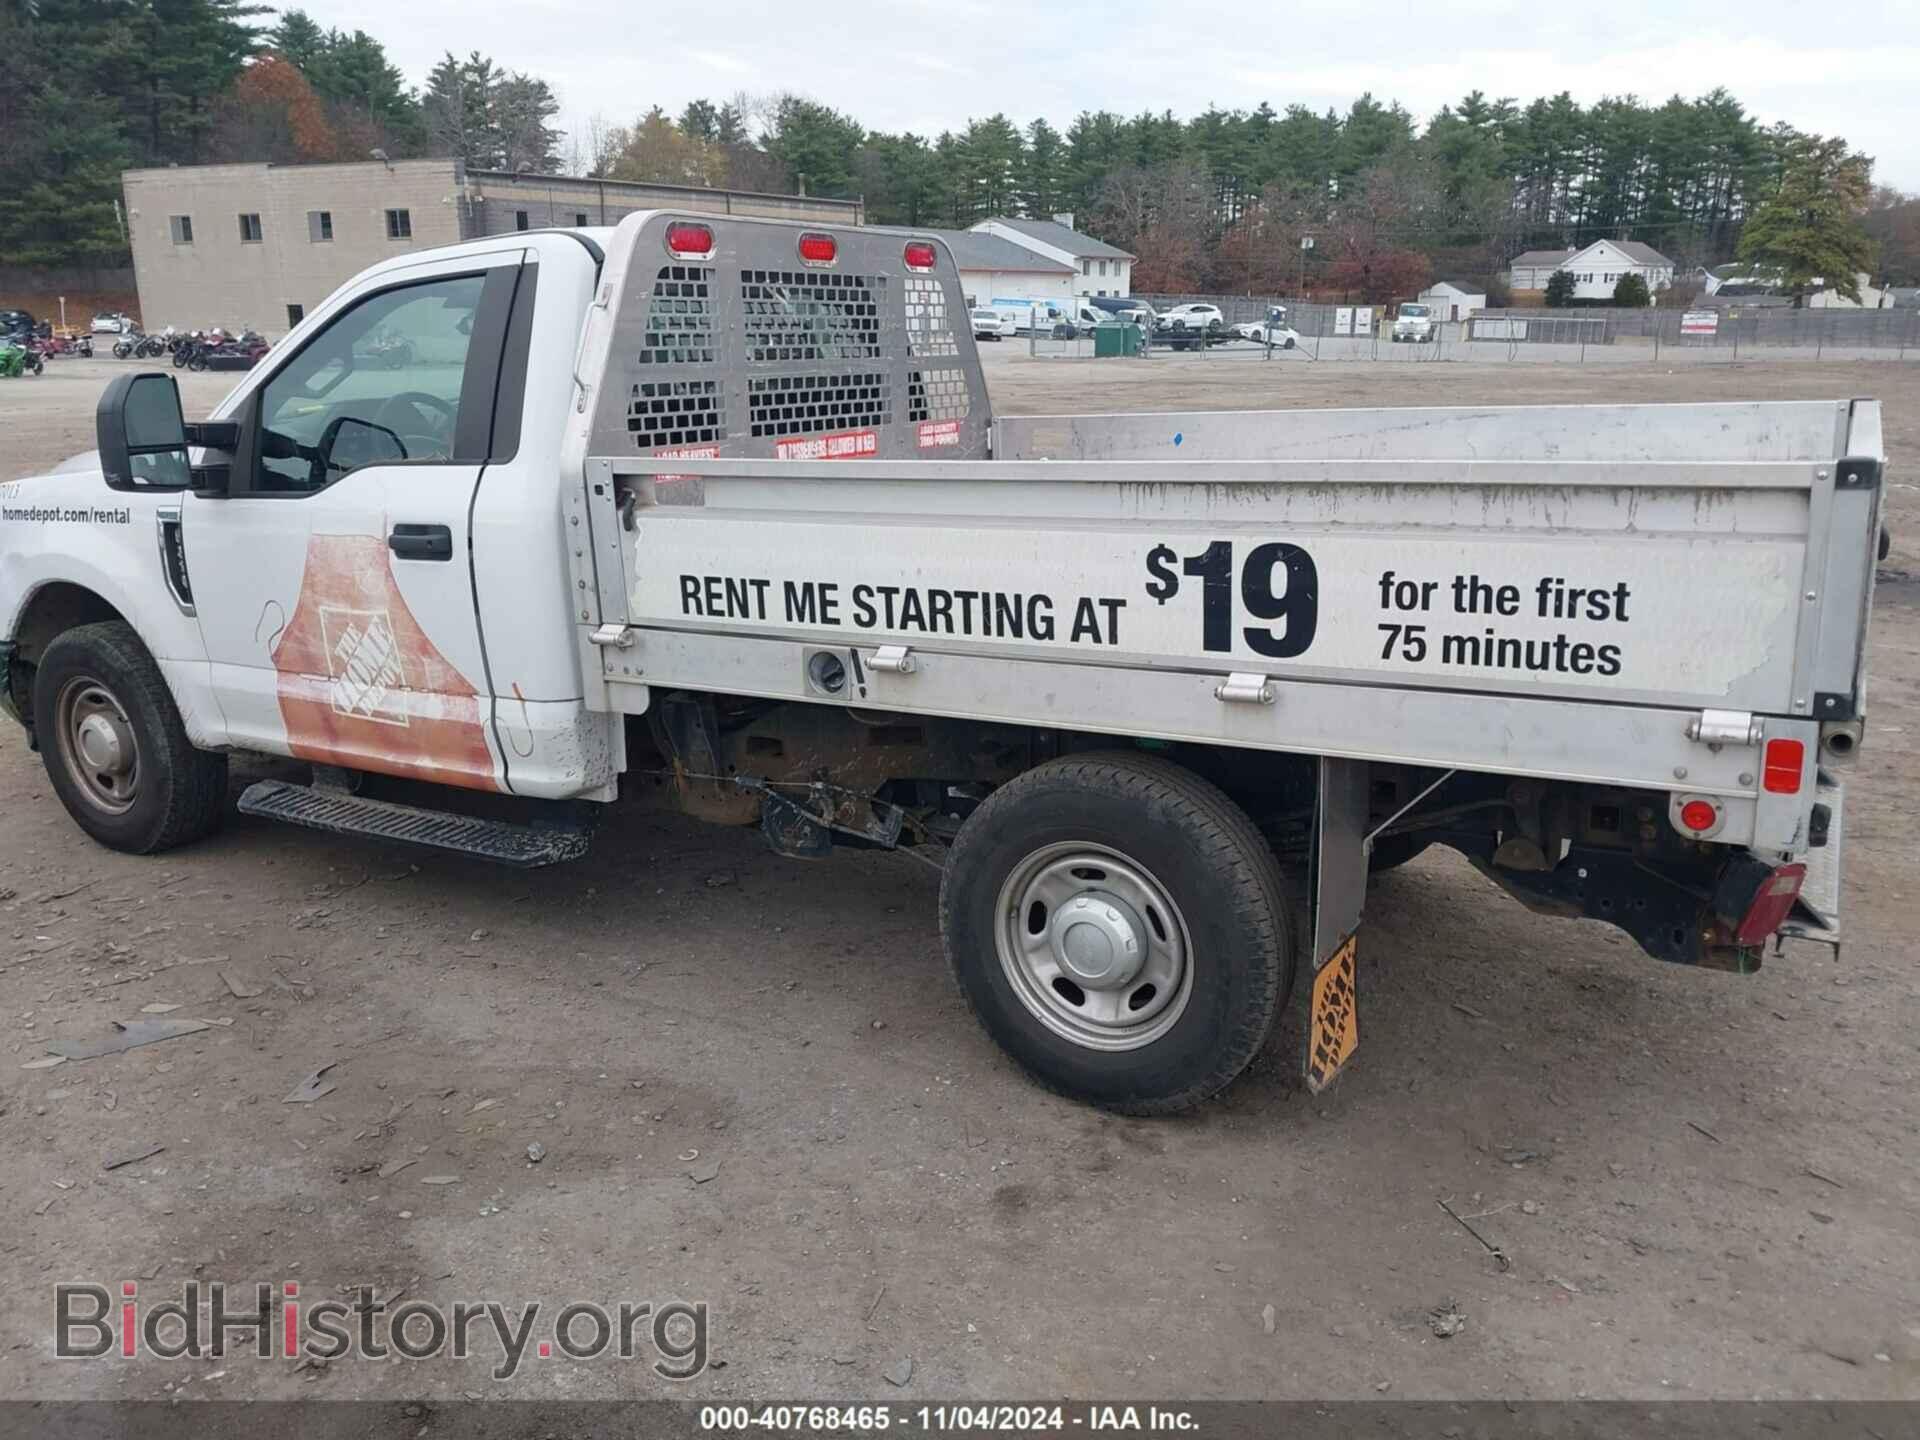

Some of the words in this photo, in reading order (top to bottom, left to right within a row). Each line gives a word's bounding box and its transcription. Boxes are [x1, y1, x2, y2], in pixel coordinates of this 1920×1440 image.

[2, 505, 131, 525] homedepot.com/rental
[679, 574, 770, 620] RENT
[783, 580, 841, 626] ME
[853, 584, 1055, 641] STARTING
[1070, 597, 1127, 645] AT
[1145, 540, 1319, 658] $19
[1379, 571, 1438, 612] for
[1452, 574, 1521, 617] the
[1535, 578, 1632, 623] first
[1377, 623, 1427, 663] 75
[1441, 628, 1623, 677] minutes
